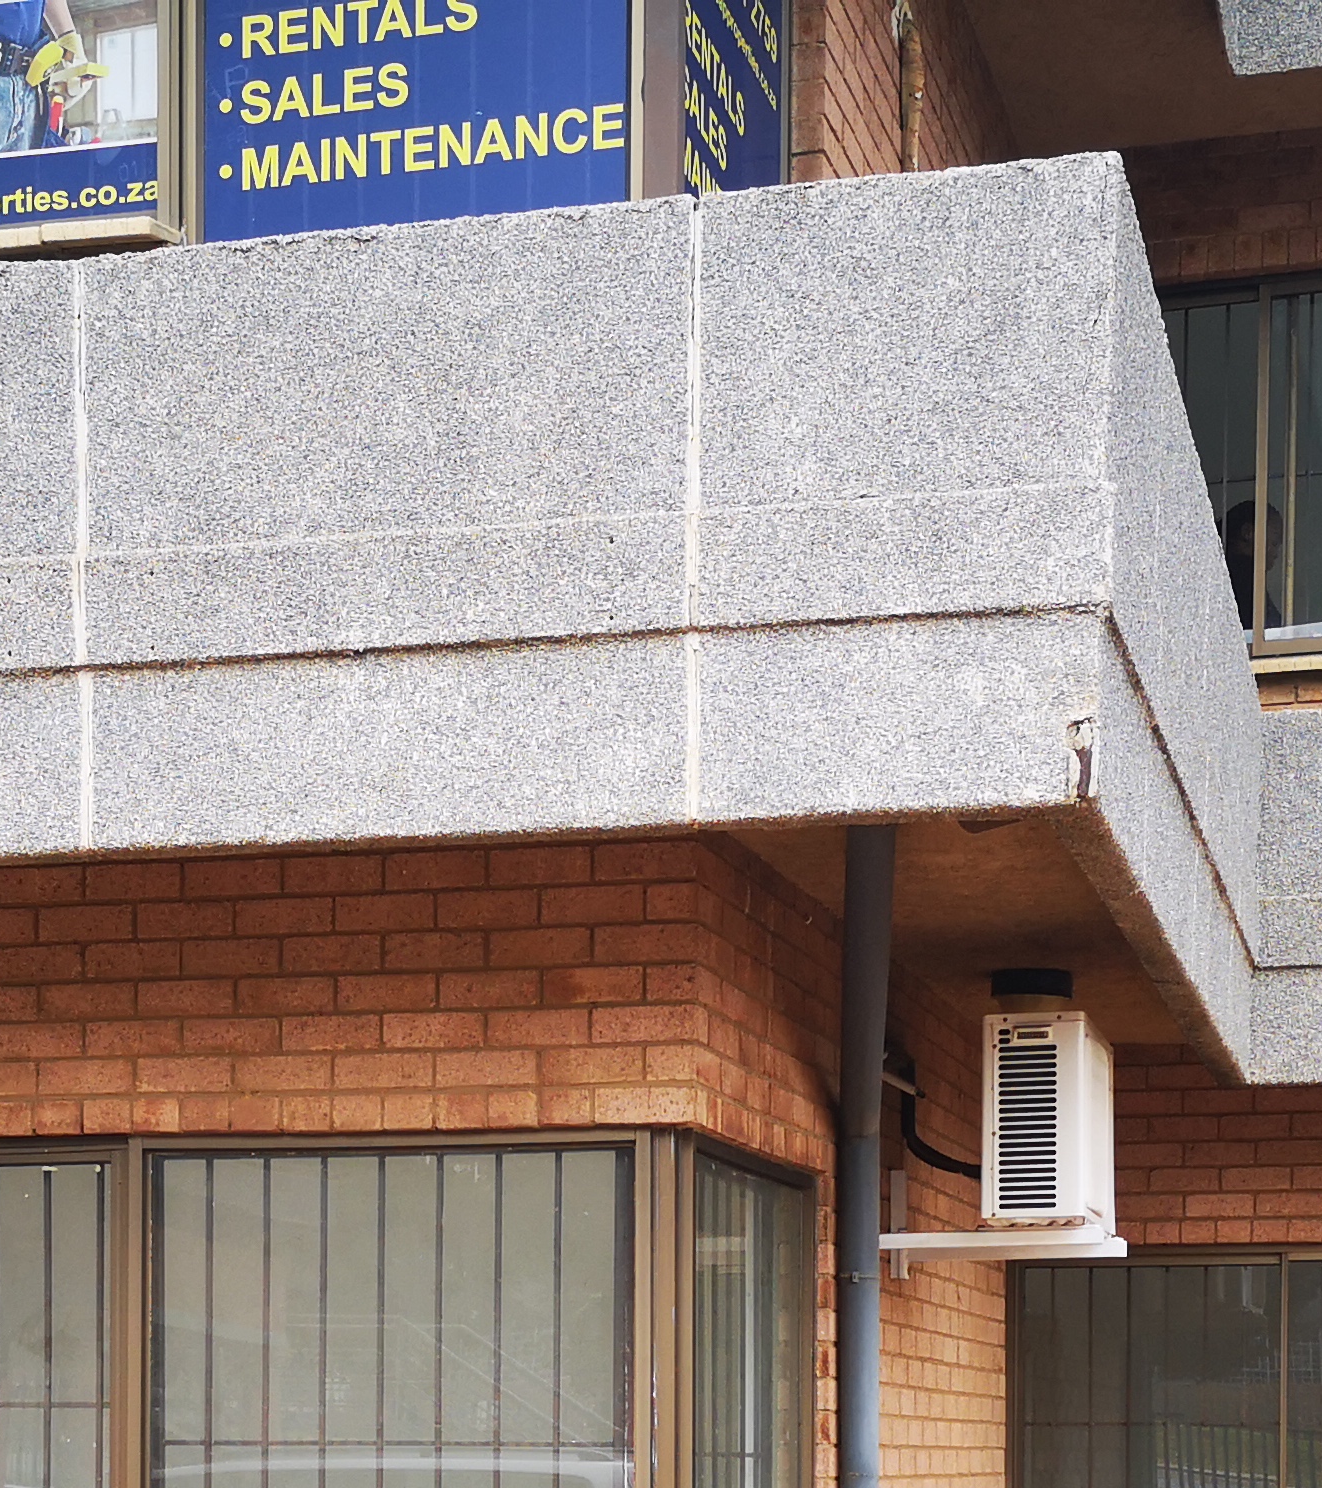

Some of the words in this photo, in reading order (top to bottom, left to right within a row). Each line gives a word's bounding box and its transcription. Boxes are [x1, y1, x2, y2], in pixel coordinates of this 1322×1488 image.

[241, 0, 478, 59] RENTALS
[685, 0, 744, 137] RENTALS
[240, 63, 410, 125] SALES
[685, 64, 727, 171] SALES
[241, 103, 626, 191] MAINTENANCE
